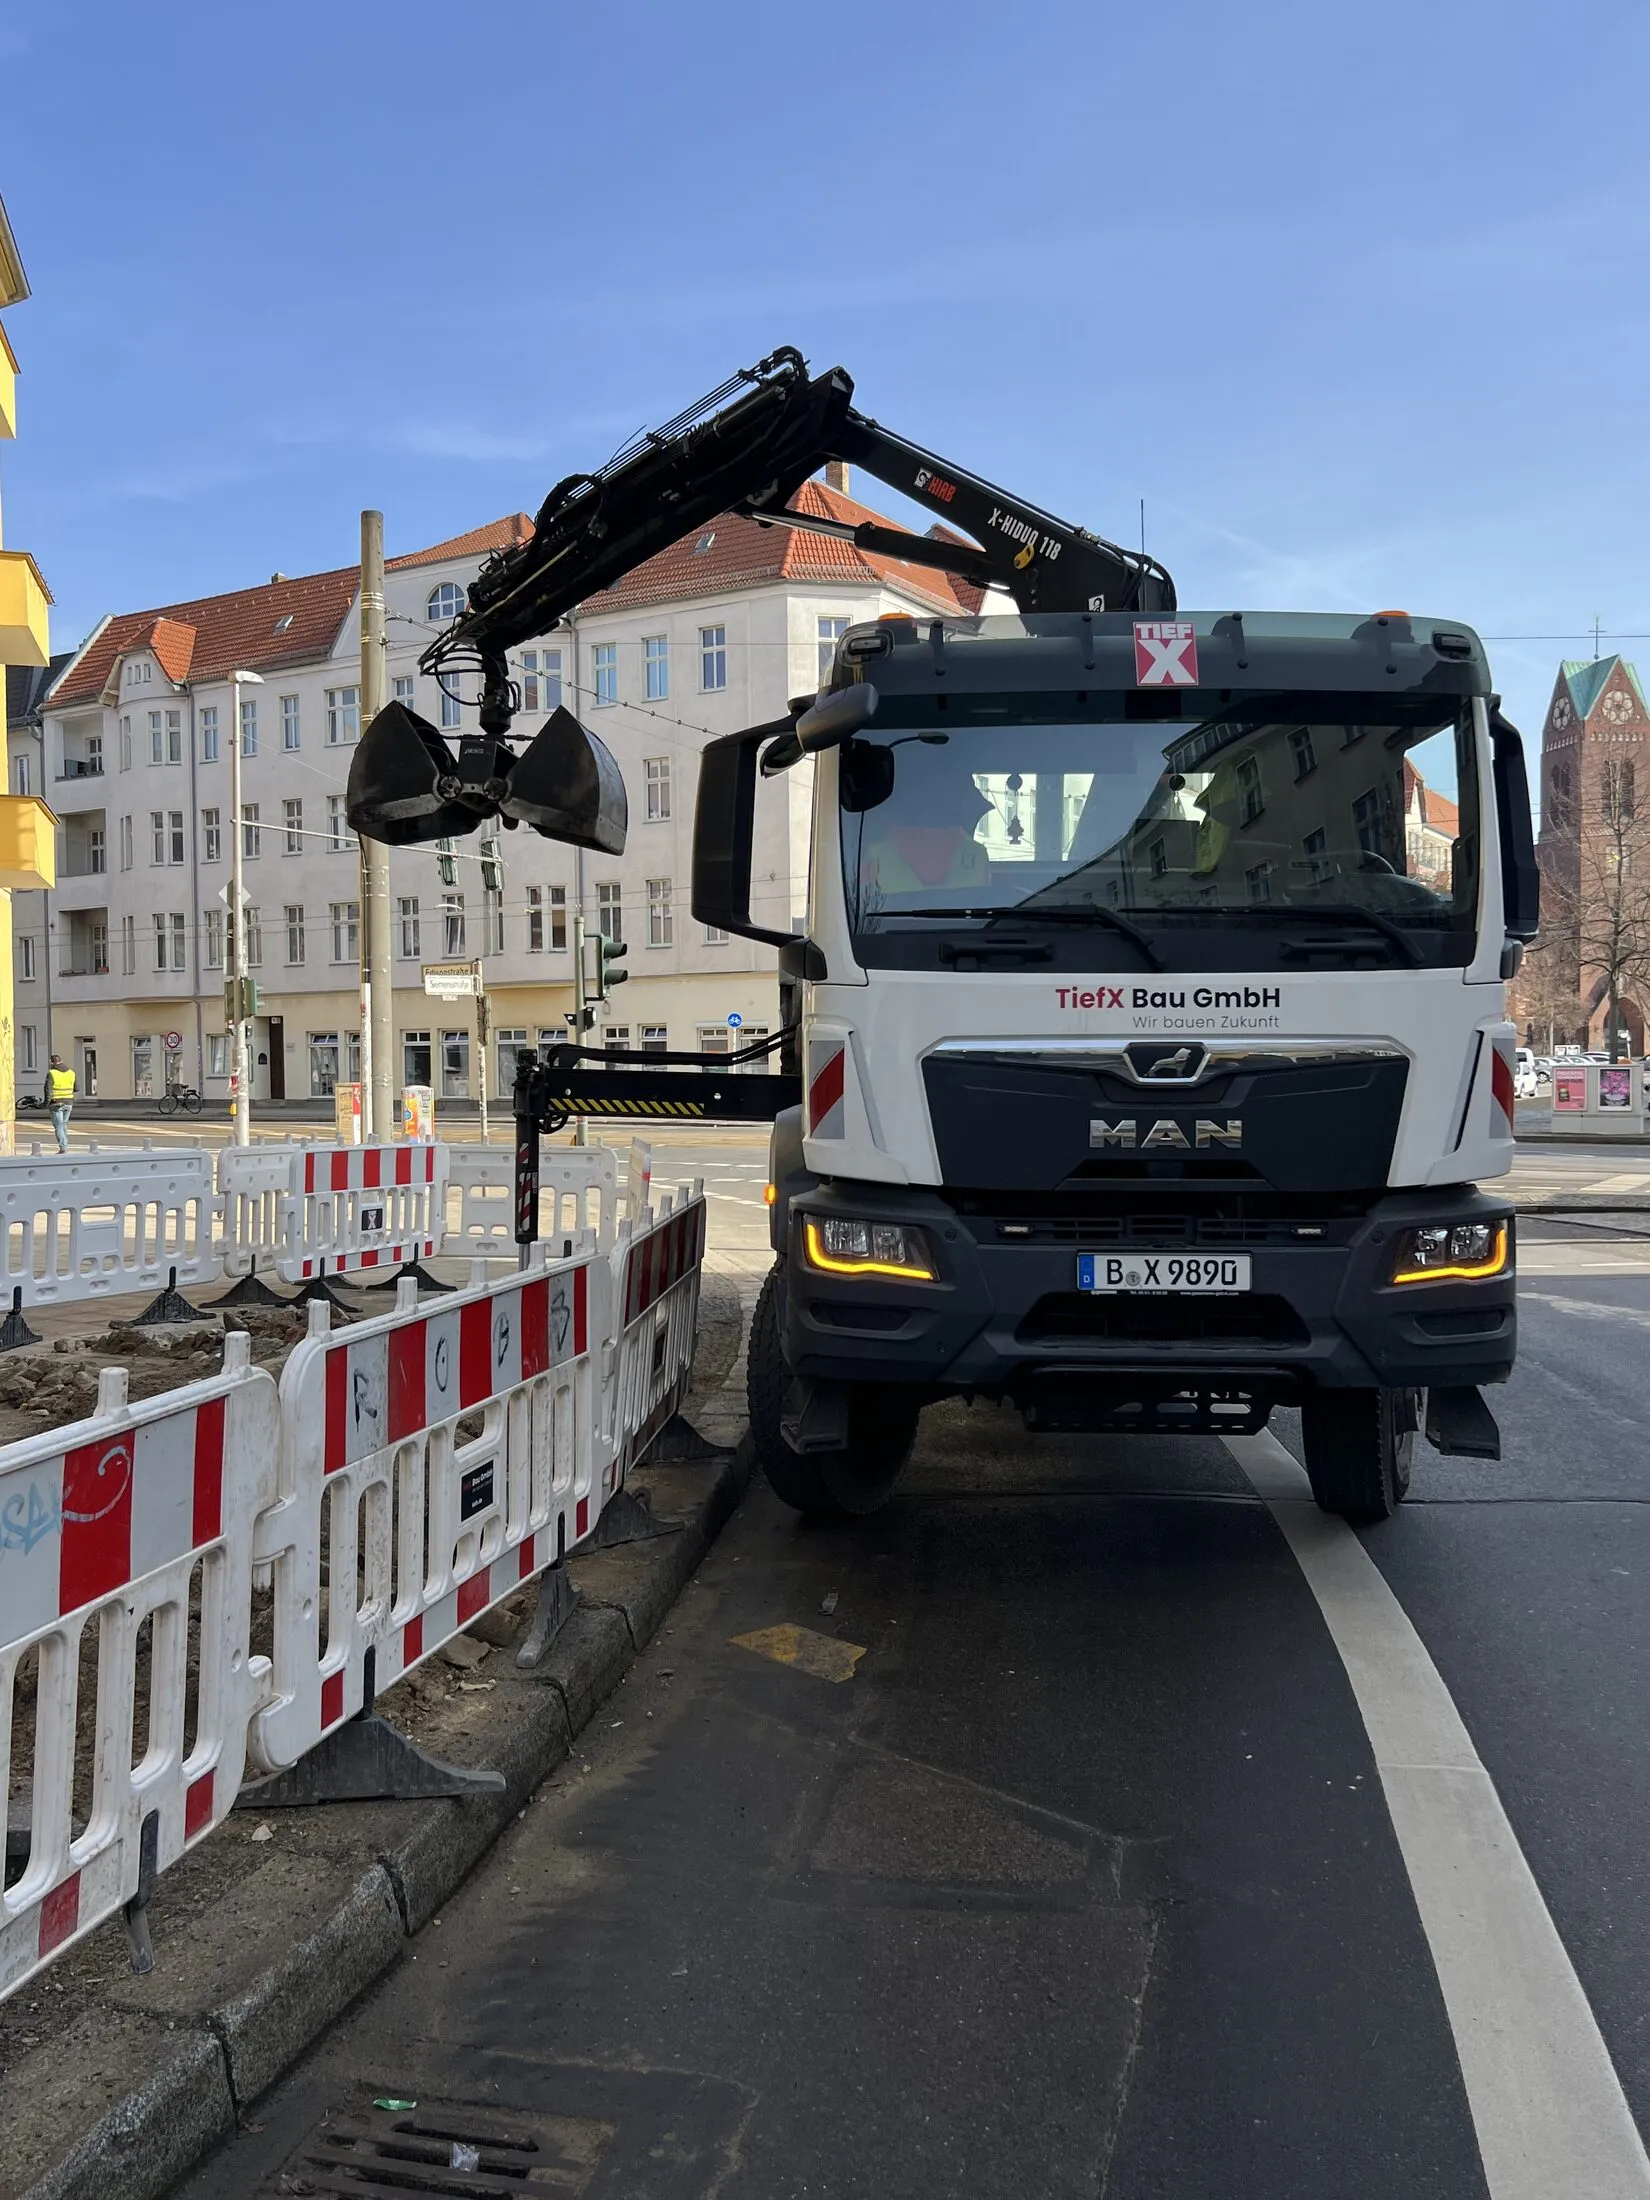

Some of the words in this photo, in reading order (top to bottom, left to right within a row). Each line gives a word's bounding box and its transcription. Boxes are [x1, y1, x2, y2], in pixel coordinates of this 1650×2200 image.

[927, 476, 957, 503] HIAB
[987, 507, 1039, 546] X-HIDUO
[1039, 536, 1062, 561] 118
[1135, 623, 1193, 639] TIEF
[1137, 639, 1196, 684] X
[1055, 986, 1124, 1009] TiefX
[1132, 988, 1185, 1009] Bau
[1193, 986, 1280, 1009] GmbH
[1132, 1016, 1157, 1028] Wir
[1163, 1015, 1215, 1029] bauen
[1221, 1015, 1279, 1029] Zukunft
[169, 1035, 178, 1045] 30
[1089, 1119, 1242, 1149] MAN
[1083, 1275, 1091, 1283] D
[1106, 1259, 1124, 1285] B
[1144, 1259, 1160, 1285] X
[1168, 1259, 1237, 1286] 9890
